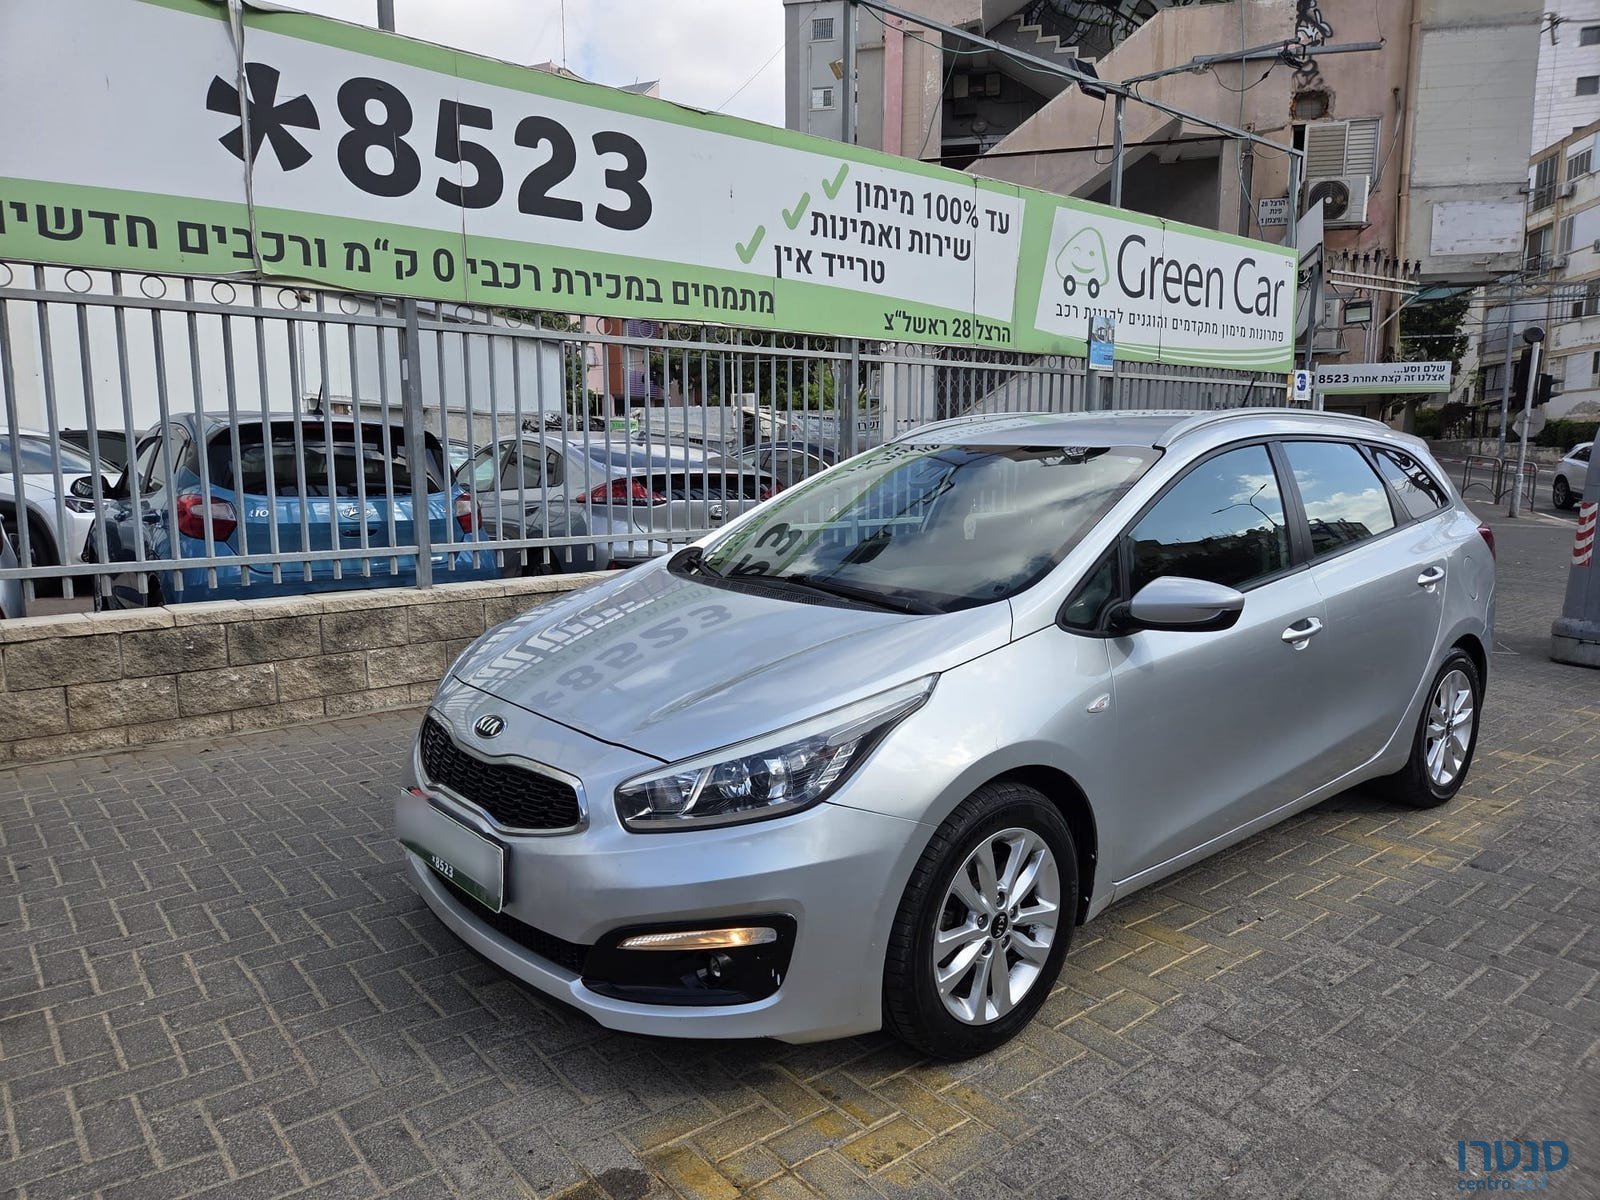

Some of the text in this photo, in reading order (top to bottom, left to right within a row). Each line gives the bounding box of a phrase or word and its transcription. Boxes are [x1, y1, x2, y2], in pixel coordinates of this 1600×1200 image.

[855, 181, 1010, 235] עד 100% מימון
[0, 200, 158, 250] חדשי
[810, 211, 971, 261] שירות ואמינות
[177, 220, 327, 268] ורכבים
[466, 258, 541, 292] רכבי
[774, 244, 885, 284] טרייד אין
[552, 267, 663, 303] במכירת
[1117, 234, 1285, 318] Green Car
[672, 280, 775, 314] מתמחים
[1056, 303, 1079, 319] רכב
[1128, 312, 1167, 329] והוגנים
[952, 317, 971, 339] 28
[976, 319, 1011, 343] הרצל
[1172, 317, 1218, 335] מתקדמים
[1222, 322, 1246, 339] מימון
[1249, 327, 1284, 342] פתרונות
[1318, 372, 1445, 384] אצלנו זה קצת אחרת 8523
[1424, 364, 1445, 373] שלם
[476, 716, 501, 735] KIA
[995, 915, 1006, 937] KIA
